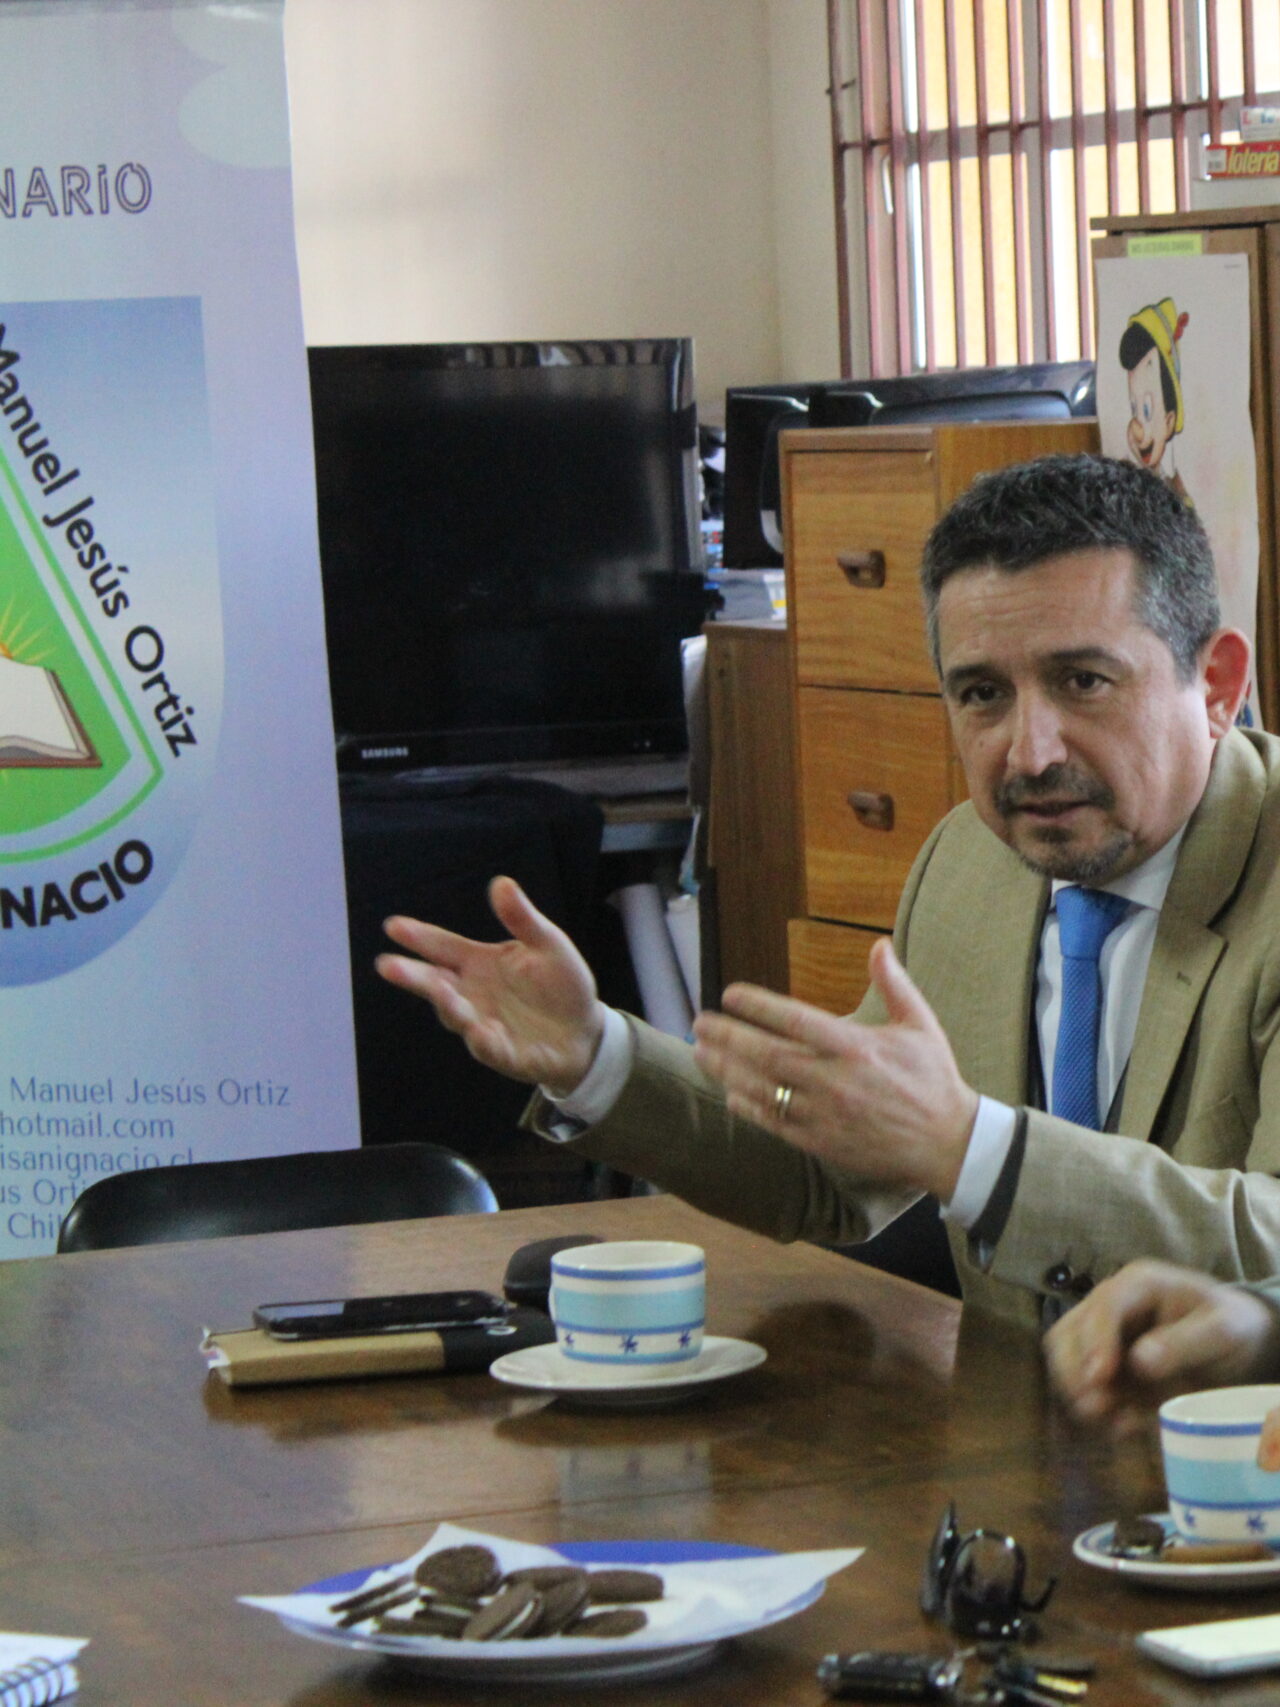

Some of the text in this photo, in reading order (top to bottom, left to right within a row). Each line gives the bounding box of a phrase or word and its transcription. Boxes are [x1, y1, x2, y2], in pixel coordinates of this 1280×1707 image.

[42, 496, 130, 619] Jesús
[124, 624, 198, 759] Ortiz
[0, 839, 154, 929] NACIO
[10, 1076, 290, 1107] Manuel Jesús Ortiz
[0, 1111, 175, 1139] hotmail.com
[0, 1144, 193, 1179] isanignaciocl
